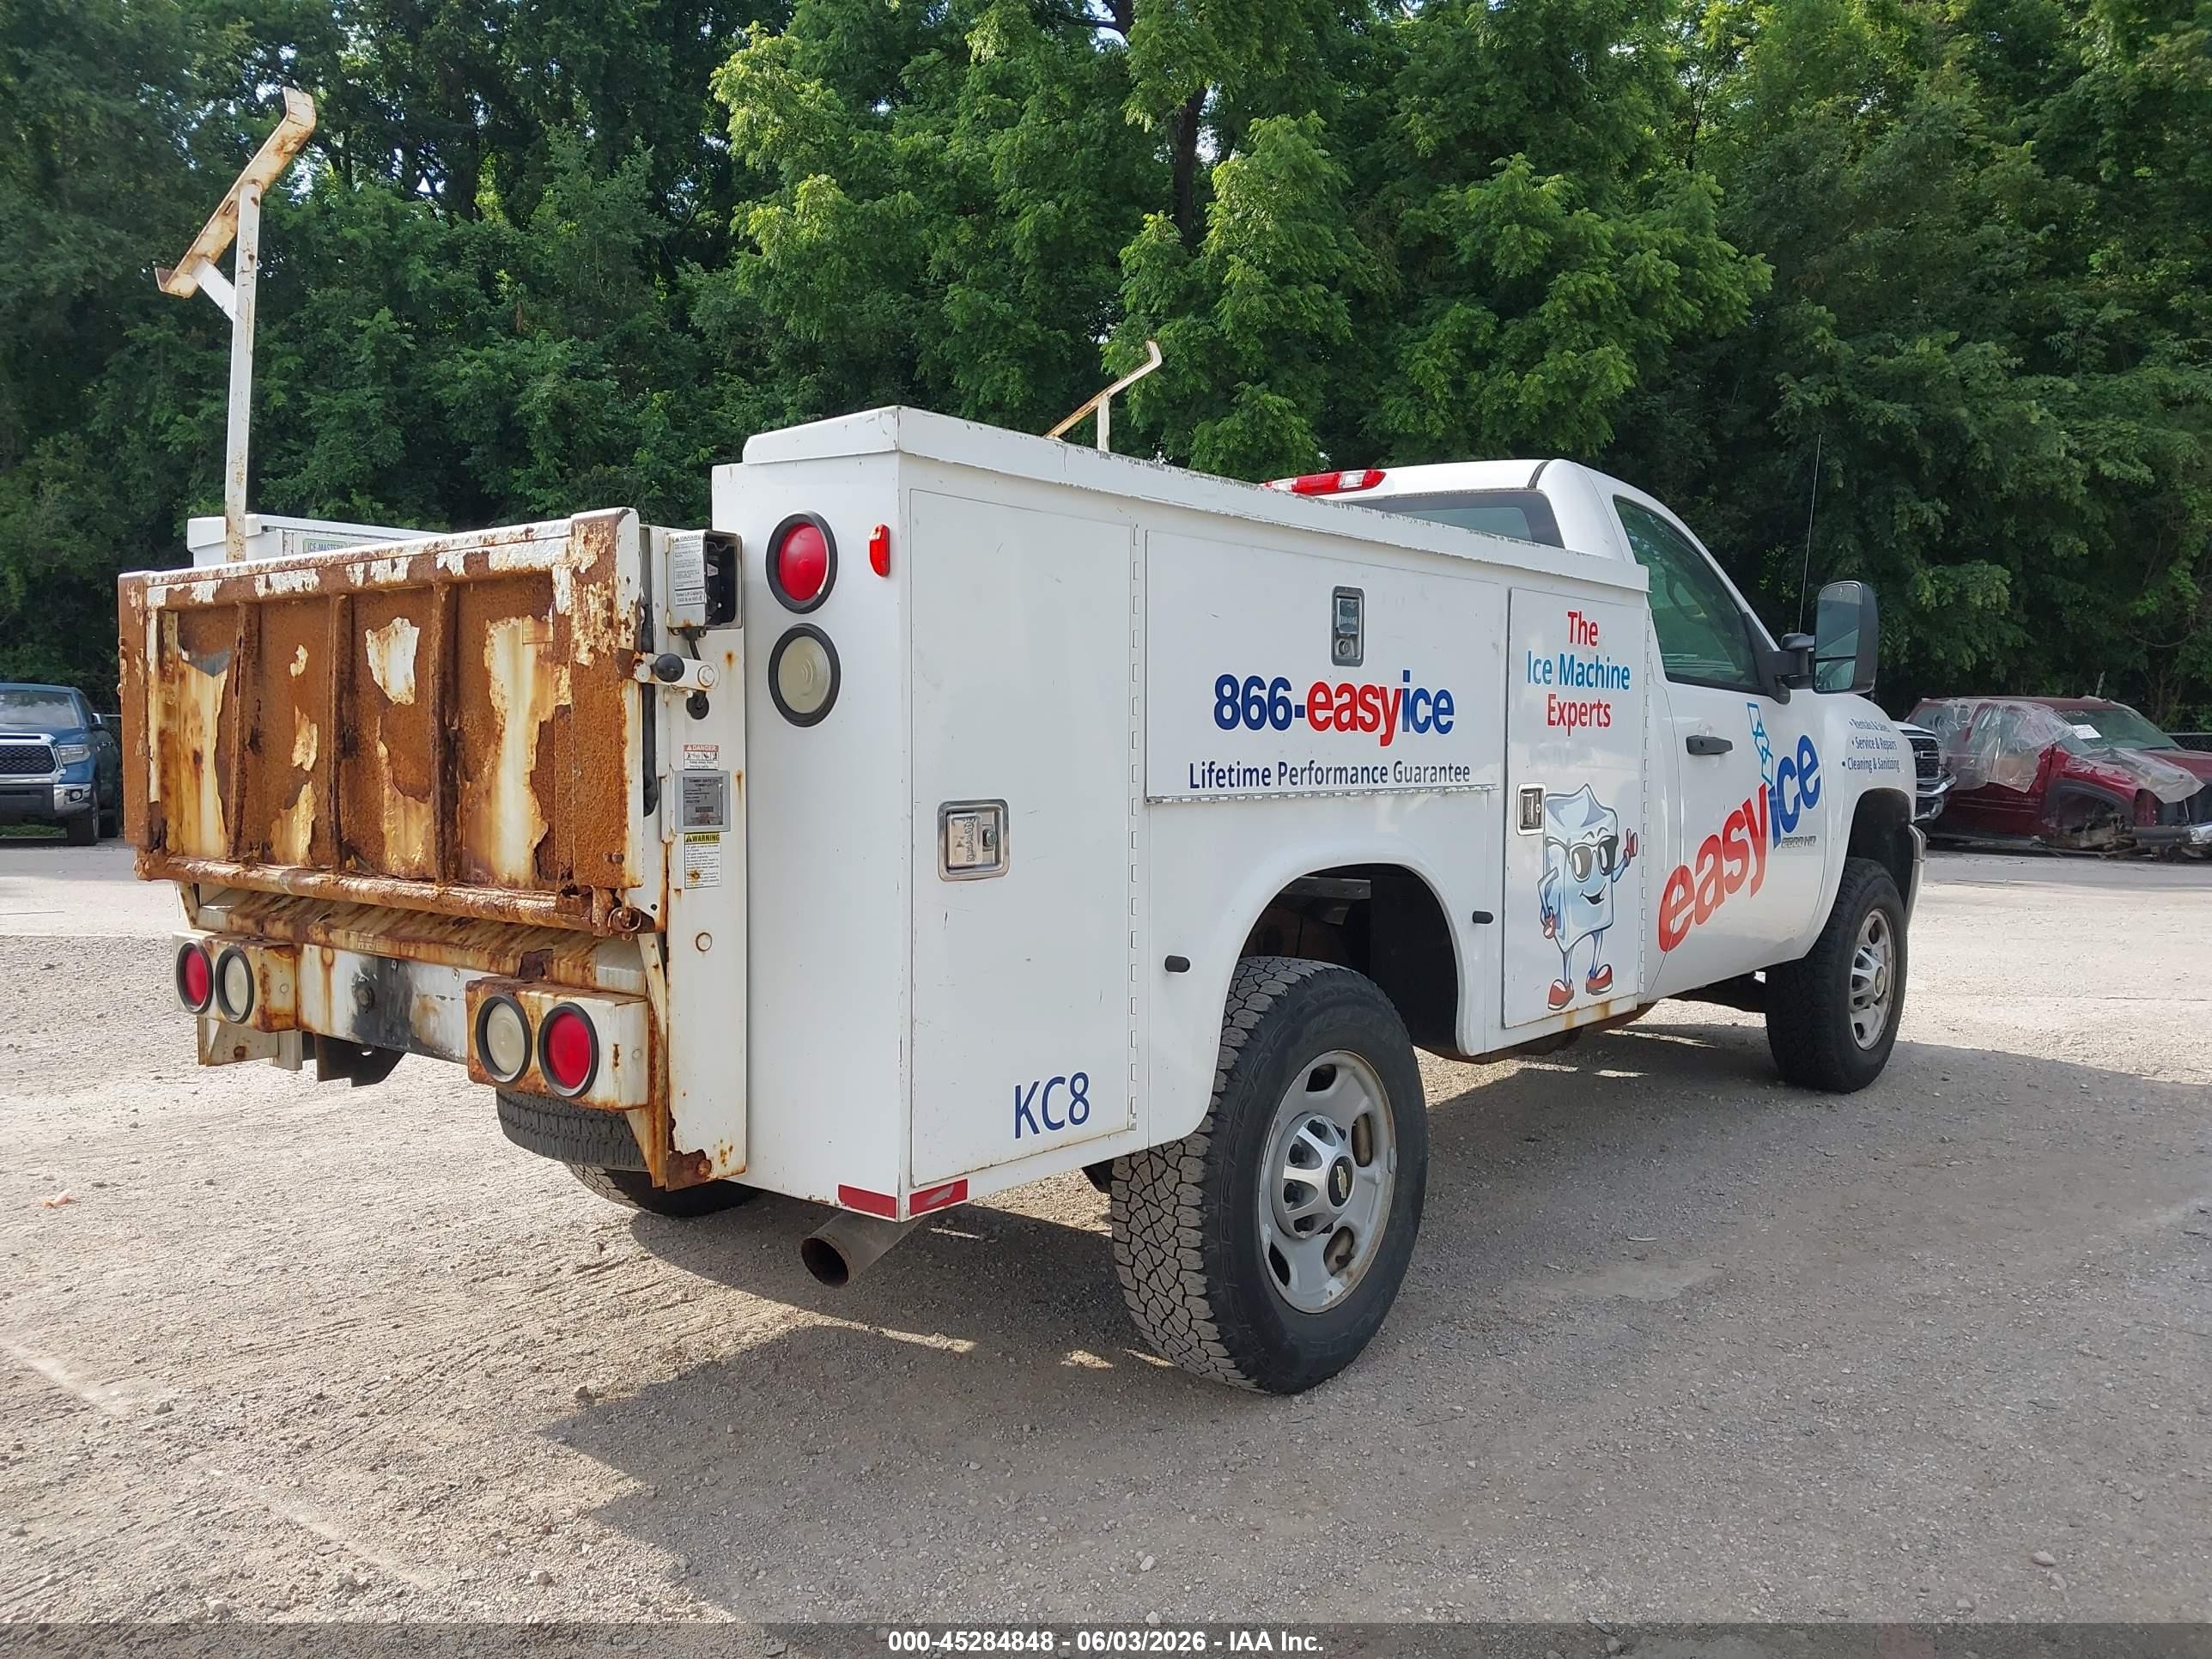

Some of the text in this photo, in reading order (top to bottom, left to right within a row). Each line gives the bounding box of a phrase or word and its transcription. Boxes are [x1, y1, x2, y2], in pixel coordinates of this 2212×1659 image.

[1567, 611, 1598, 647] The
[1528, 650, 1631, 690] Ice Machine
[1213, 670, 1455, 746] 866-easyice
[1547, 693, 1611, 737] Experts
[1855, 736, 1898, 755] Service & Repairs
[1189, 760, 1470, 789] Lifetime Performance Guarantee
[1847, 757, 1900, 774] Cleaning & Sanitizing
[692, 834, 720, 842] WARNING
[1658, 734, 1821, 953] easyice
[1015, 1072, 1090, 1139] KC8
